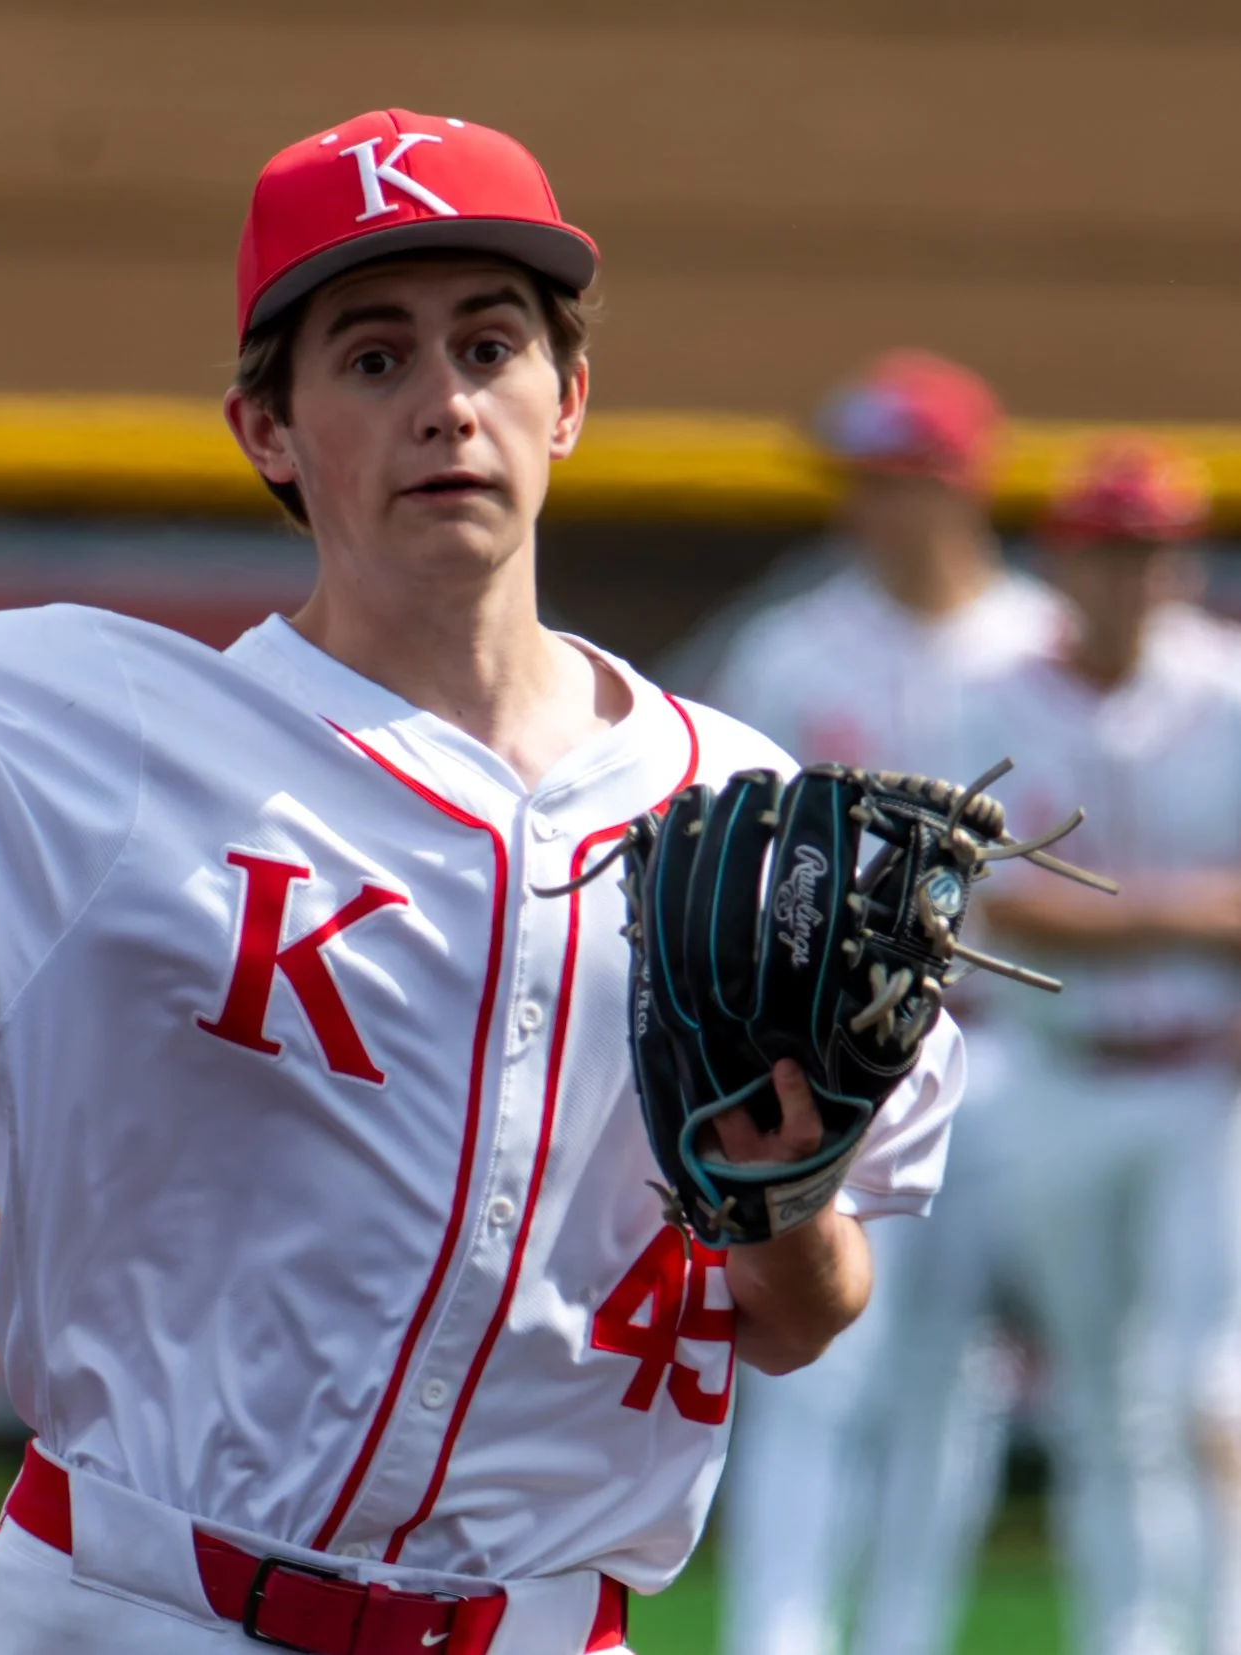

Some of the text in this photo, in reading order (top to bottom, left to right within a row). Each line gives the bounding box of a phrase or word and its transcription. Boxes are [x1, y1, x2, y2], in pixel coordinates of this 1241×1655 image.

[339, 133, 459, 222] K
[193, 849, 410, 1087] K
[777, 844, 828, 967] Rawlings
[591, 1224, 735, 1425] 45
